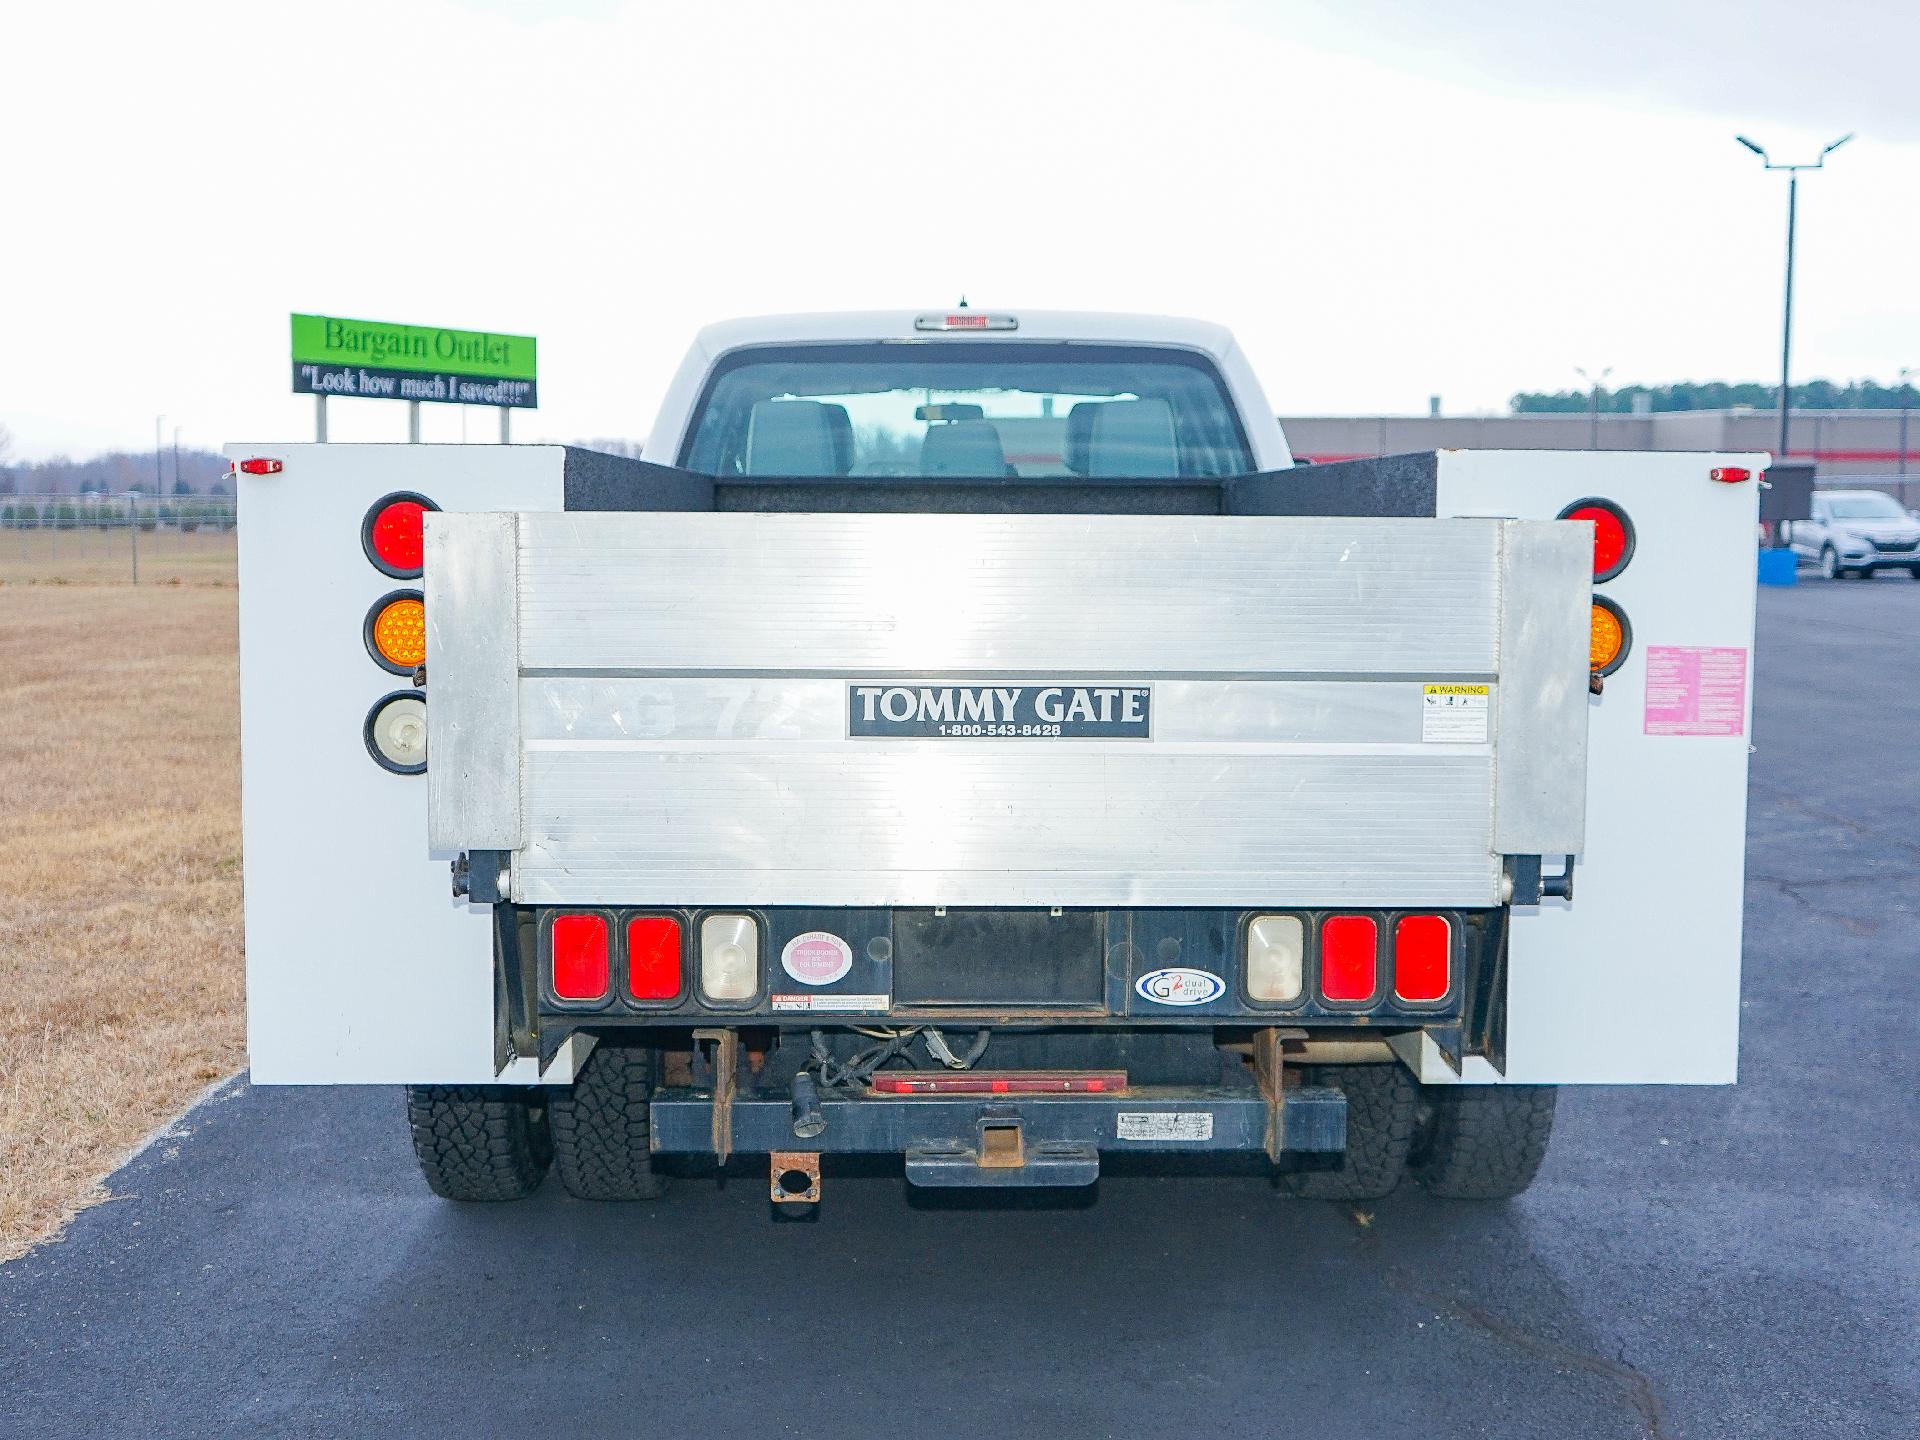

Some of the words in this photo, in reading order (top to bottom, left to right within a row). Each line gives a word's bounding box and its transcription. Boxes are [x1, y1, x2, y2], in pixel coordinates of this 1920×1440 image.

[324, 319, 427, 361] Bargain
[435, 329, 511, 365] Outlet
[301, 364, 357, 392] "Look
[359, 369, 395, 394] how
[400, 375, 445, 399] much
[449, 376, 456, 400] I
[1440, 686, 1484, 694] WARNING
[857, 688, 1023, 722] TOMMY
[938, 724, 1062, 737] 1-800-543-8428
[1184, 979, 1206, 988] dual
[1183, 988, 1209, 996] drive
